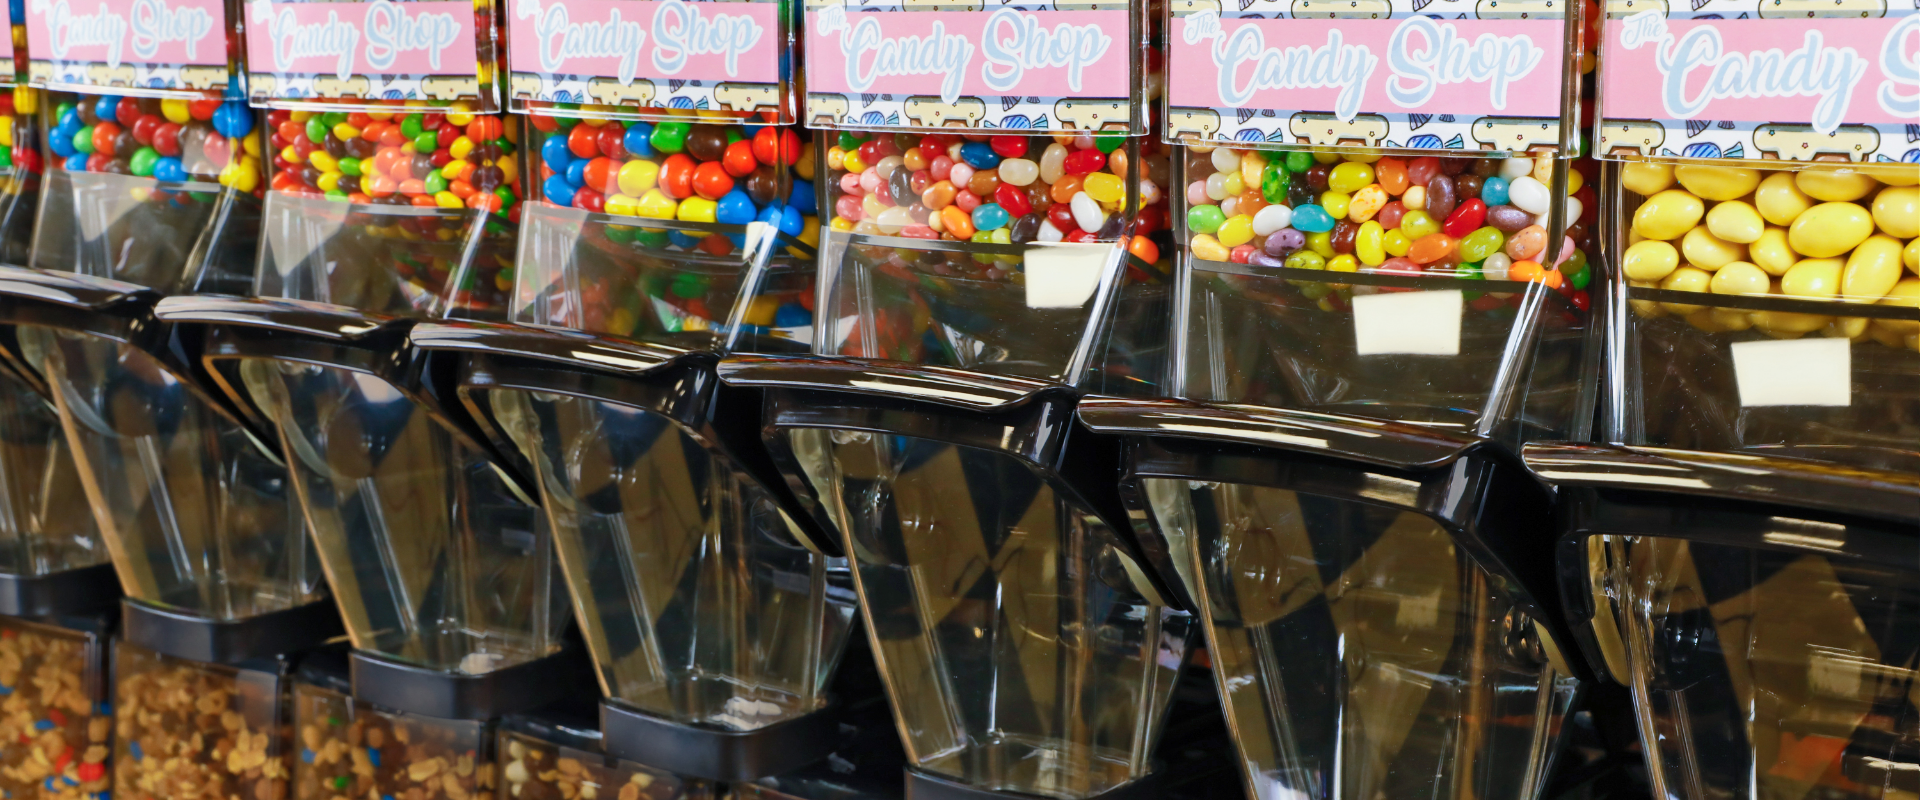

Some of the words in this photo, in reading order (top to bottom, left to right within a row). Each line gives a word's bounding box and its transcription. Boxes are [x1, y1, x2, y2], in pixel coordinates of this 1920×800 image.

[47, 1, 127, 68] Candy
[132, 0, 212, 59] Shop
[270, 8, 358, 80] Candy
[365, 1, 460, 69] Shop
[536, 4, 645, 85] Candy
[653, 1, 762, 76] Shop
[842, 17, 973, 103] Candy
[983, 8, 1110, 91] Shop
[1185, 10, 1219, 43] The
[1213, 24, 1377, 121] Candy
[1388, 16, 1542, 109] Shop
[1622, 11, 1666, 48] The
[1657, 26, 1866, 132] Candy
